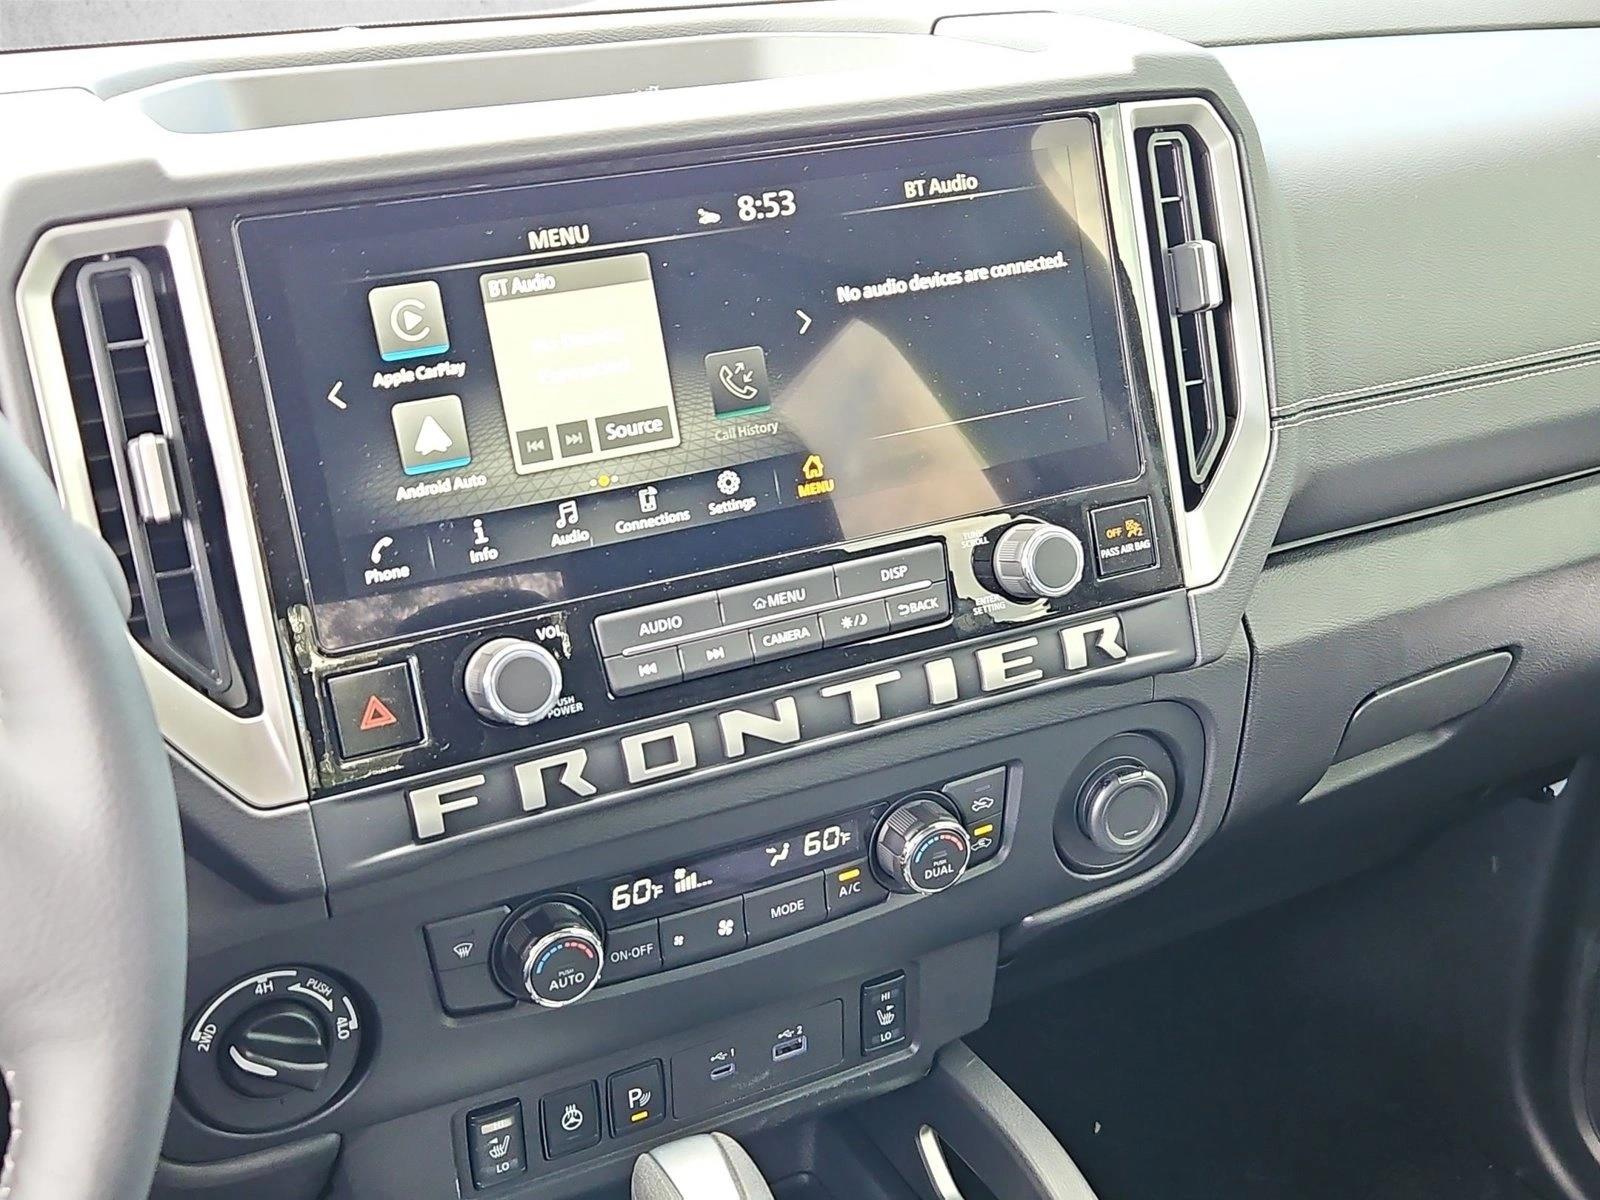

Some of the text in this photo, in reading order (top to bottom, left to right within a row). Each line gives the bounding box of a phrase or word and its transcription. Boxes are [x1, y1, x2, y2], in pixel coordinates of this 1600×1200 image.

[904, 174, 979, 199] BT Audio
[737, 189, 797, 222] 8:53
[527, 224, 590, 250] MENU
[487, 272, 556, 298] BT Audio
[836, 253, 1067, 303] No audio devices are connected.
[372, 360, 466, 389] Apple CarPlay
[604, 418, 664, 441] Source
[714, 418, 779, 441] Call History
[396, 472, 487, 501] Android Auto
[798, 478, 835, 497] MENU
[708, 494, 757, 517] Settings
[615, 508, 691, 534] Connections
[550, 527, 590, 547] Audio
[961, 536, 990, 549] SCROLL
[1106, 528, 1123, 539] OFF
[469, 544, 499, 563] Info
[1100, 539, 1151, 559] PASS AIR BAG
[364, 563, 411, 585] Phone
[880, 565, 909, 582] DISP
[767, 587, 807, 608] MENU
[909, 597, 939, 613] BACK
[973, 601, 1007, 616] SETTING
[535, 624, 563, 641] VOL
[638, 615, 683, 636] AUDIO
[762, 625, 811, 647] CAMERA
[547, 702, 584, 718] POWER
[557, 695, 575, 707] USH
[408, 616, 1127, 839] FRONTIER
[924, 864, 955, 880] DUAL
[838, 881, 862, 898] A/C
[770, 900, 805, 919] MODE
[254, 980, 274, 995] 4H
[306, 977, 334, 997] PUSH
[549, 972, 585, 992] AUTO
[880, 990, 891, 1002] HI
[197, 1023, 217, 1052] 2WD
[336, 1016, 350, 1040] 4LO
[880, 1032, 892, 1043] LO
[496, 1162, 510, 1174] LO
